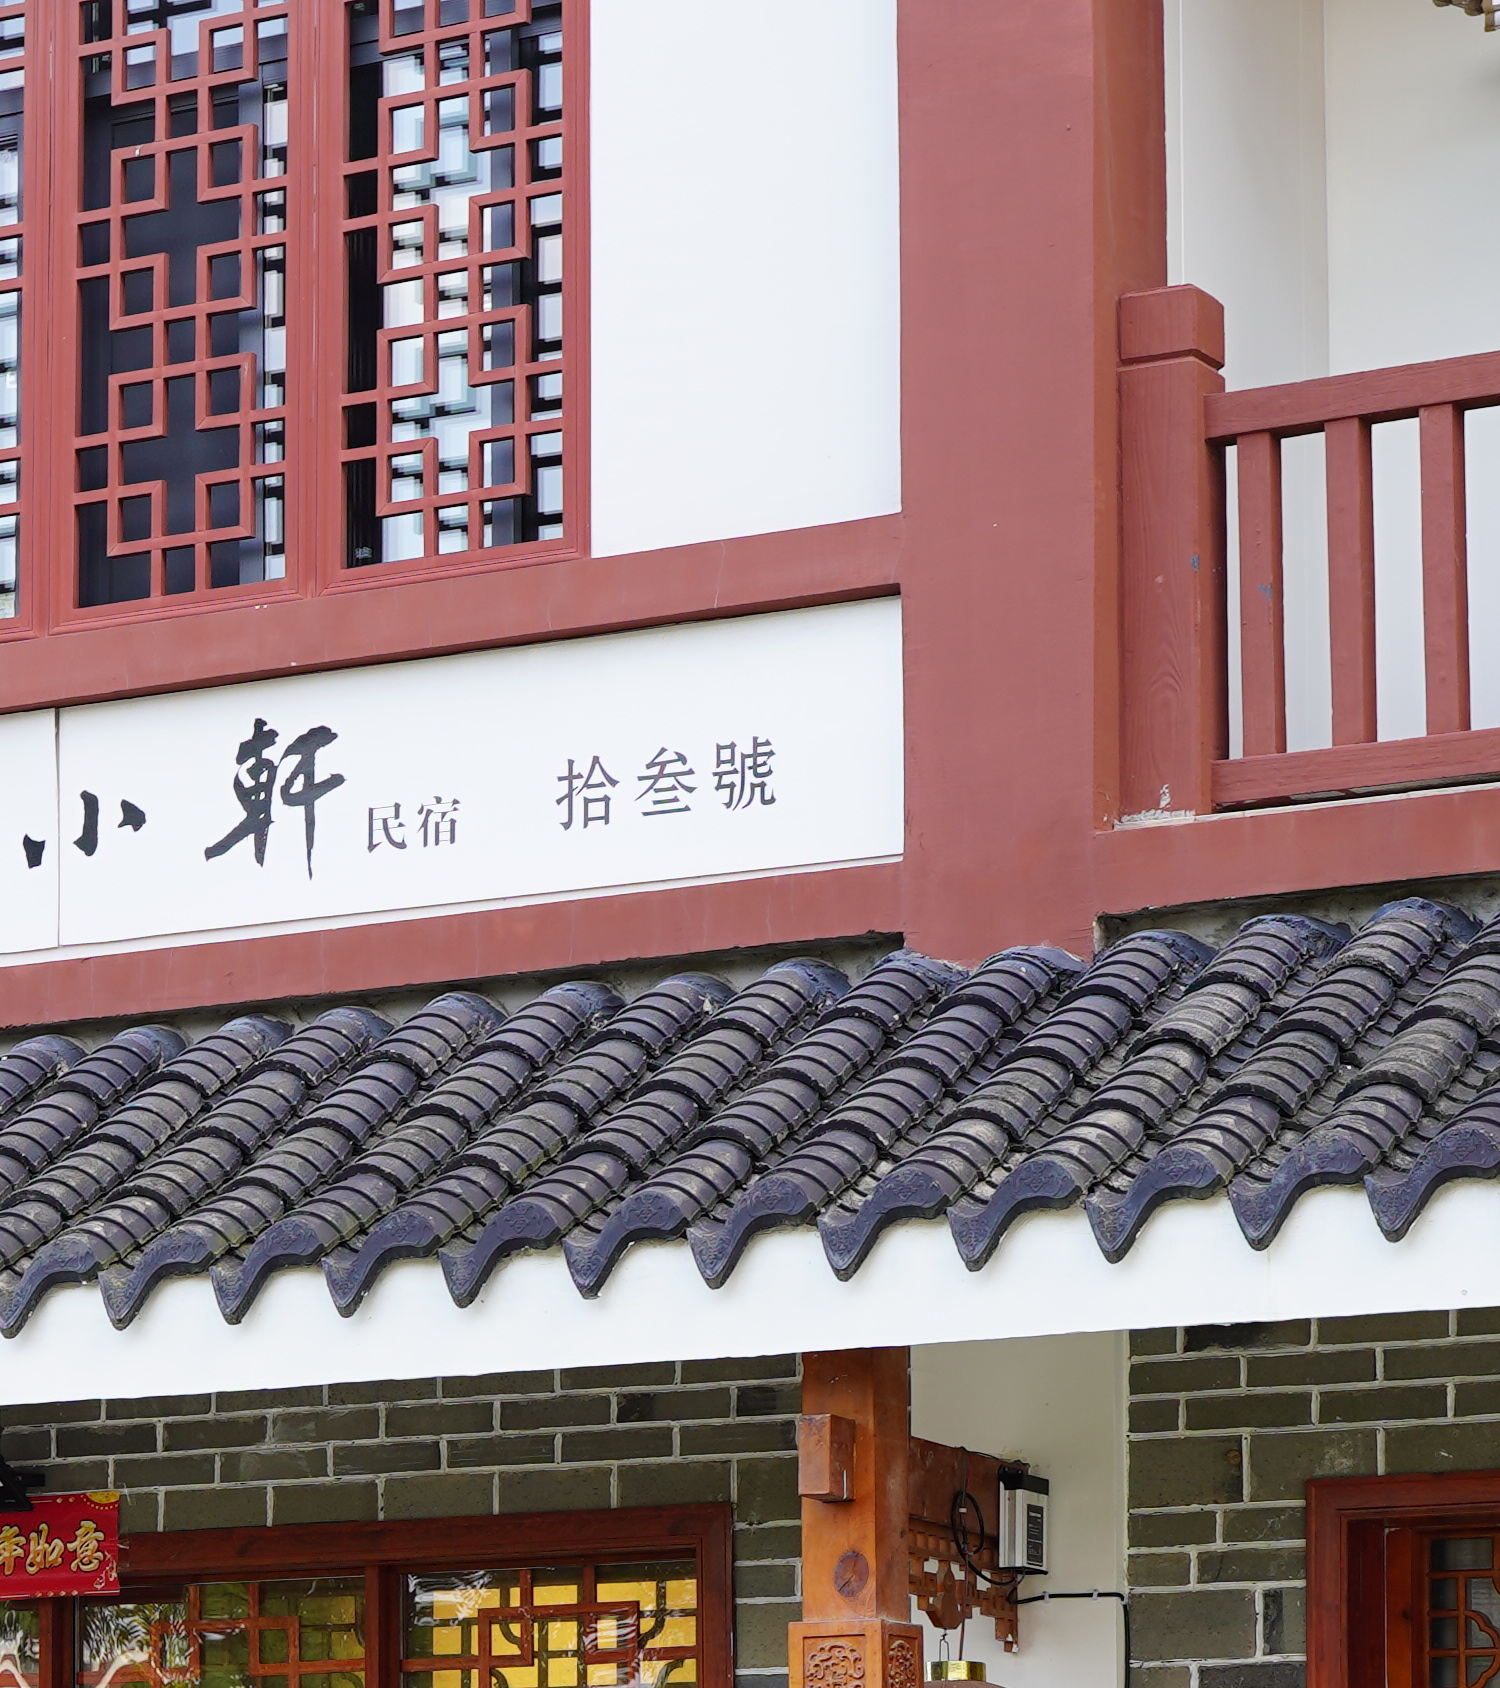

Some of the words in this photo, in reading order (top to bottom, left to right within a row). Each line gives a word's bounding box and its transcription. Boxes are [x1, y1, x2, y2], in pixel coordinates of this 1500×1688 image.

[366, 795, 463, 854] 民宿
[555, 735, 778, 831] 拾叁號
